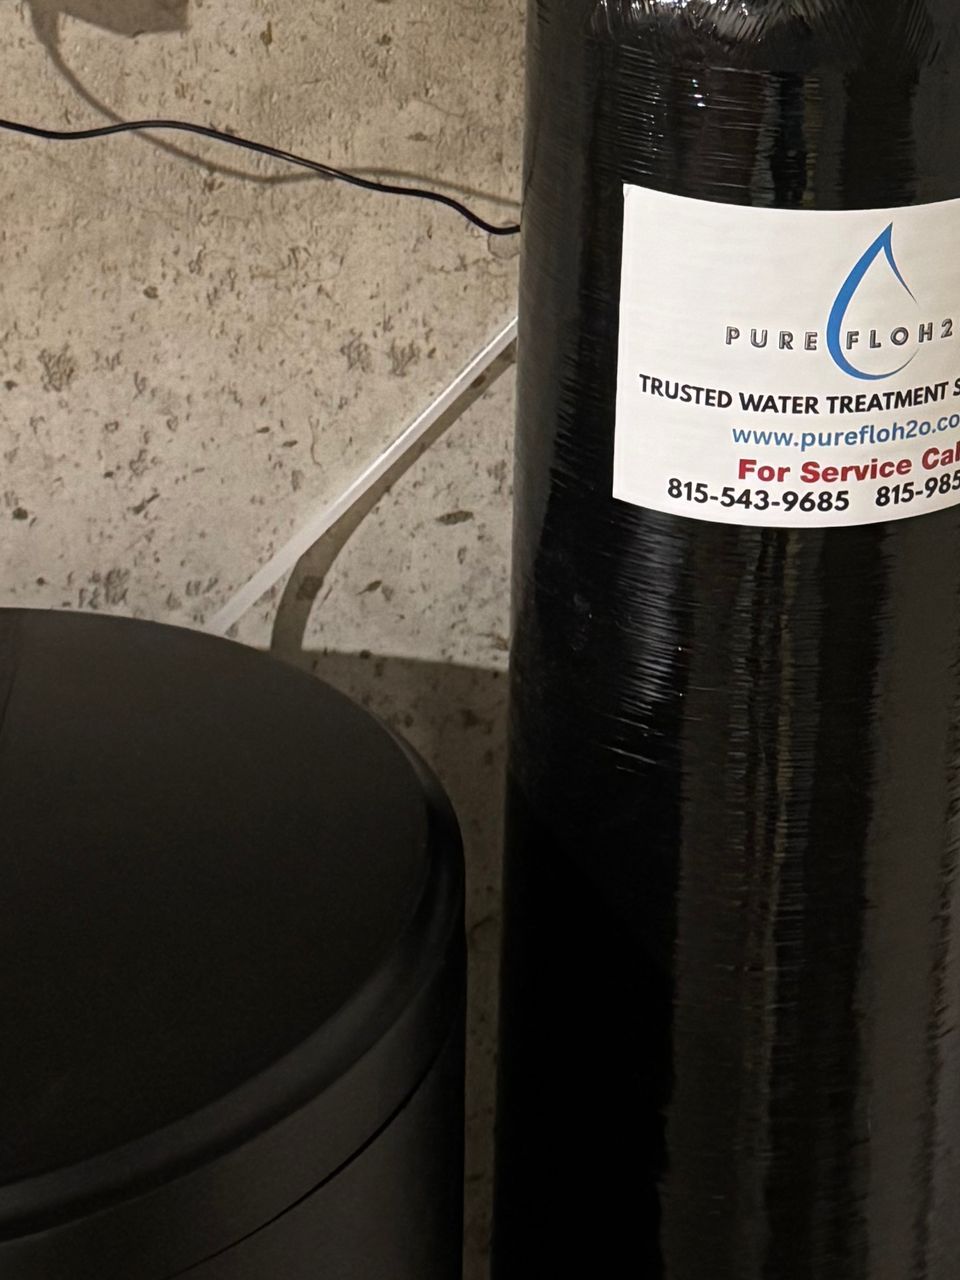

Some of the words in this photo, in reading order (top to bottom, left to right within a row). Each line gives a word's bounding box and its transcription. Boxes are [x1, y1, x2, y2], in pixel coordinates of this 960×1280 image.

[725, 326, 818, 351] PURE
[639, 373, 733, 409] TRUSTED
[738, 392, 820, 414] WATER
[826, 381, 949, 414] TREATMENT
[738, 458, 791, 483] For
[800, 457, 913, 484] Service
[667, 477, 850, 512] 815-543-9685
